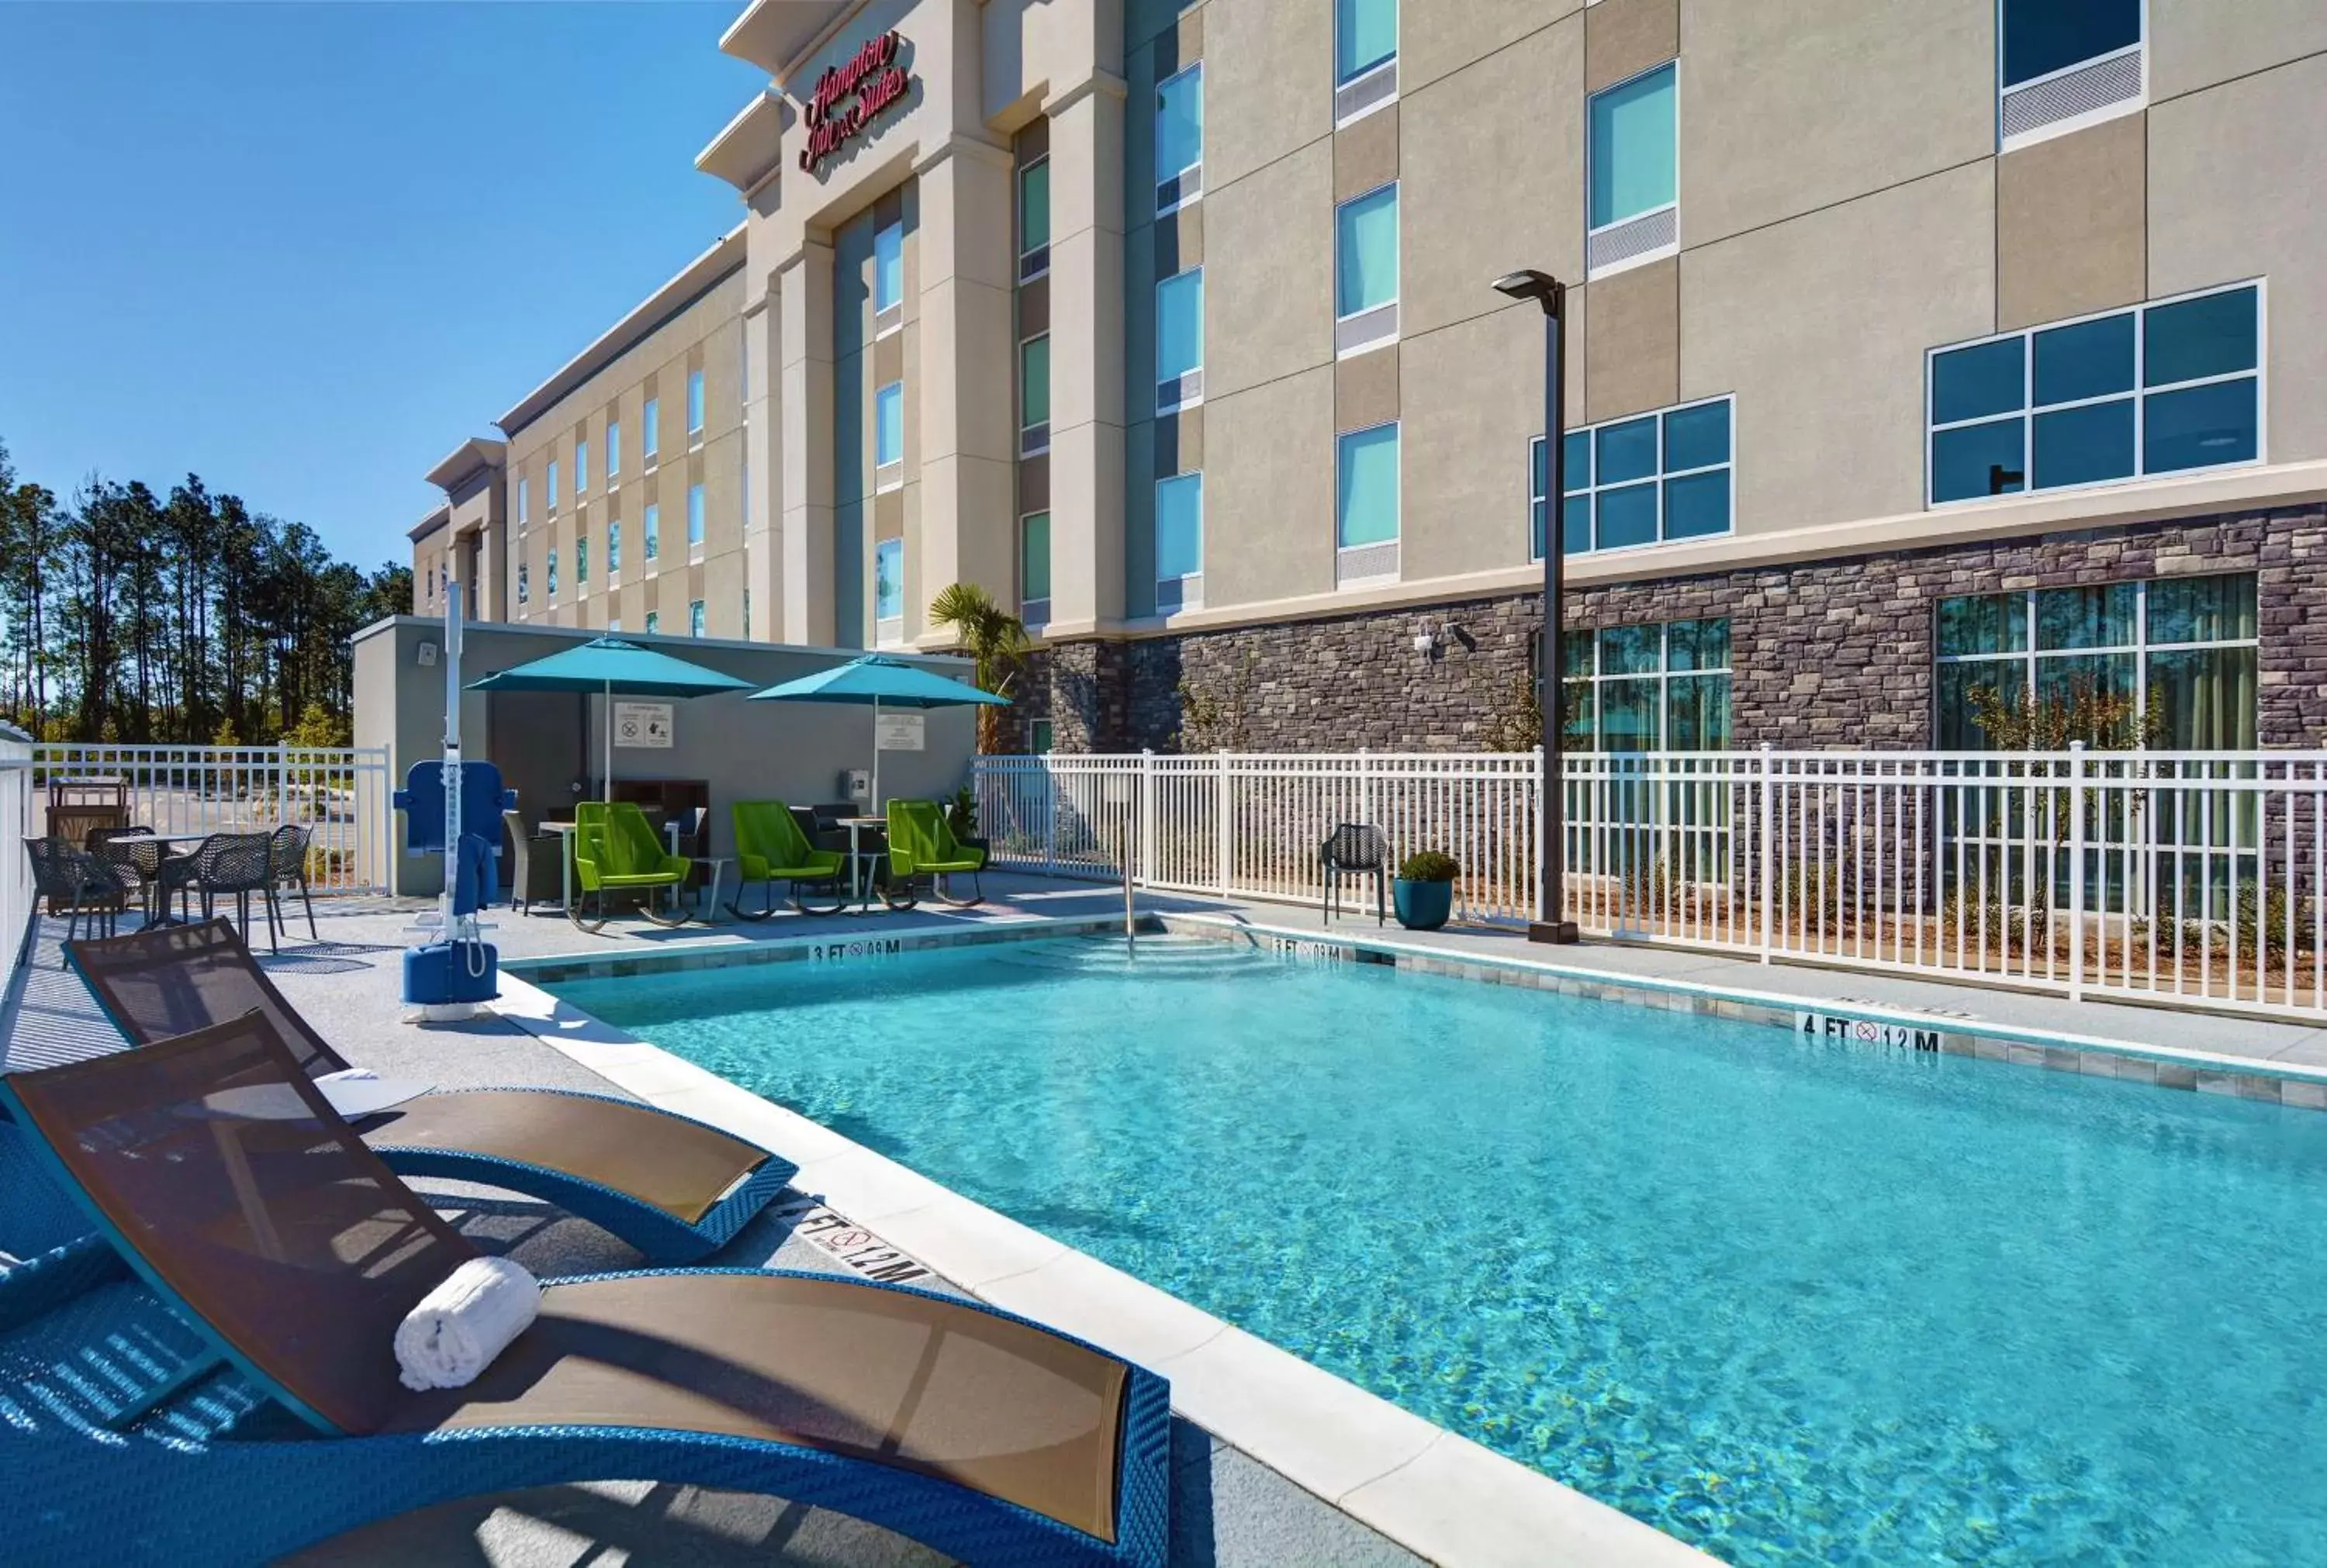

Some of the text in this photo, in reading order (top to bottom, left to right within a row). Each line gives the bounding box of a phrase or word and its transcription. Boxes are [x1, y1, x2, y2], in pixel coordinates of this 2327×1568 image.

[805, 29, 898, 130] Hampton
[800, 119, 843, 171] Inn
[856, 65, 908, 129] Suites
[829, 944, 846, 960] FT
[1803, 1014, 1815, 1034] 4
[1825, 1017, 1850, 1038] FT
[800, 1214, 851, 1235] FT
